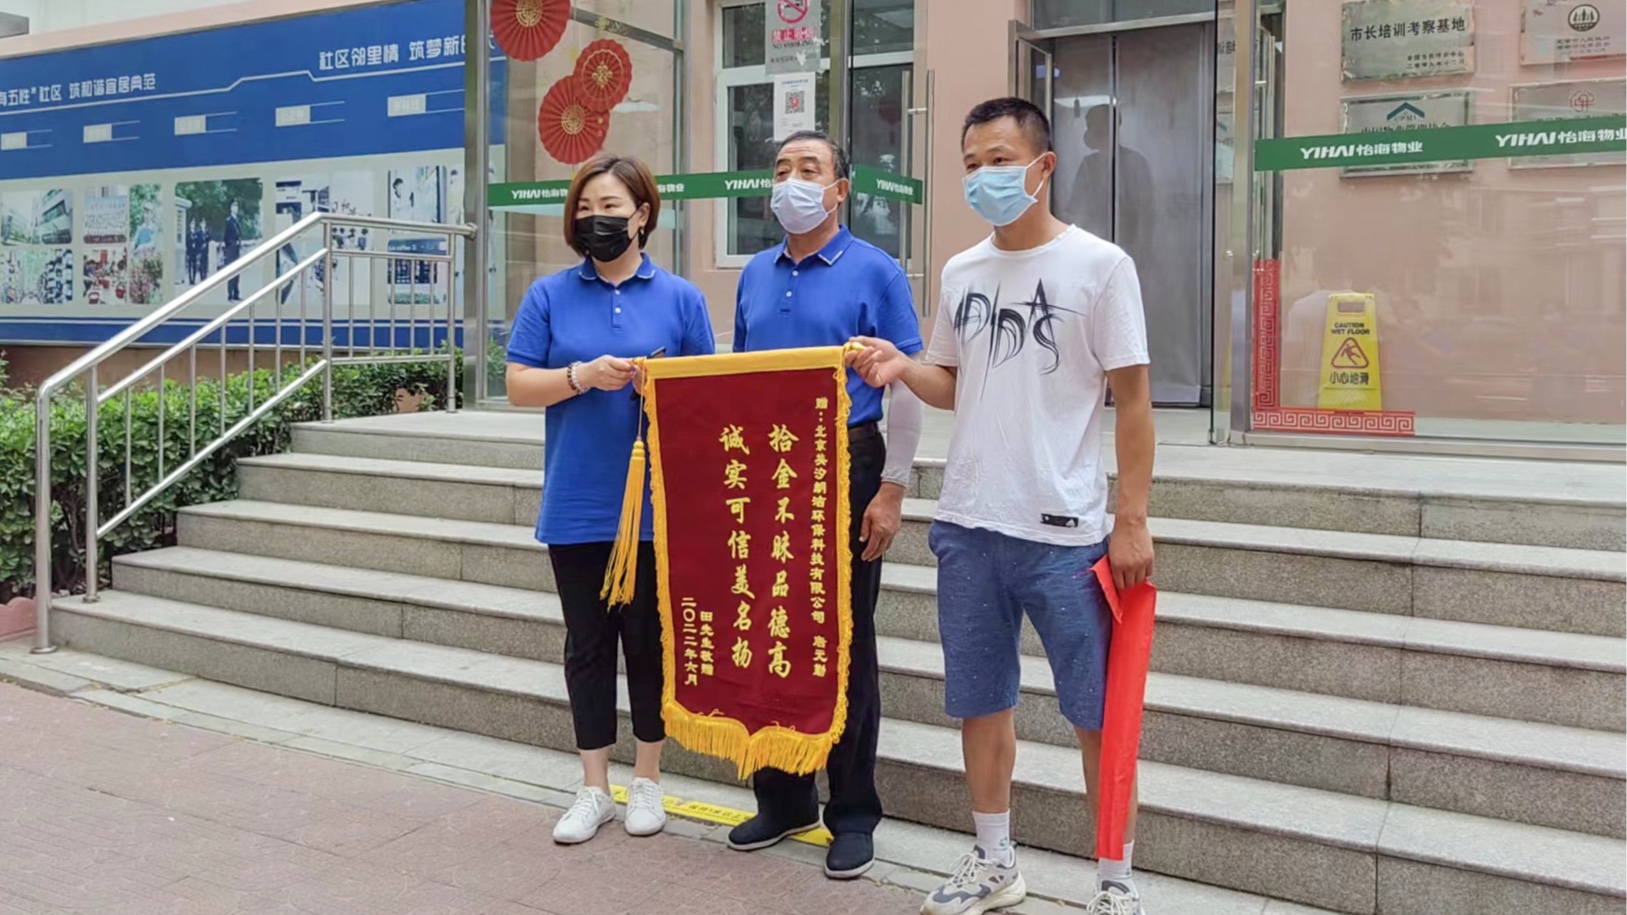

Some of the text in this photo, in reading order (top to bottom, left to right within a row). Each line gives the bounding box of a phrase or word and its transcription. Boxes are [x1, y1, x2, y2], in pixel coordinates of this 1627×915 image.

[1350, 17, 1466, 41] 市长培训考察基地
[318, 34, 466, 71] 社区邻里情 筑梦新
[69, 73, 156, 99] 筑和谐宜居典范
[1495, 128, 1627, 148] YIHAI 怡海物业
[1300, 141, 1423, 159] YIHAI 怡海物业
[511, 189, 541, 200] YIHAI
[725, 179, 760, 190] YIHAI
[1330, 371, 1370, 385] 小心地滑
[718, 424, 755, 670] 诚实可信美名扬
[767, 424, 799, 679] 拾金不昧品德高
